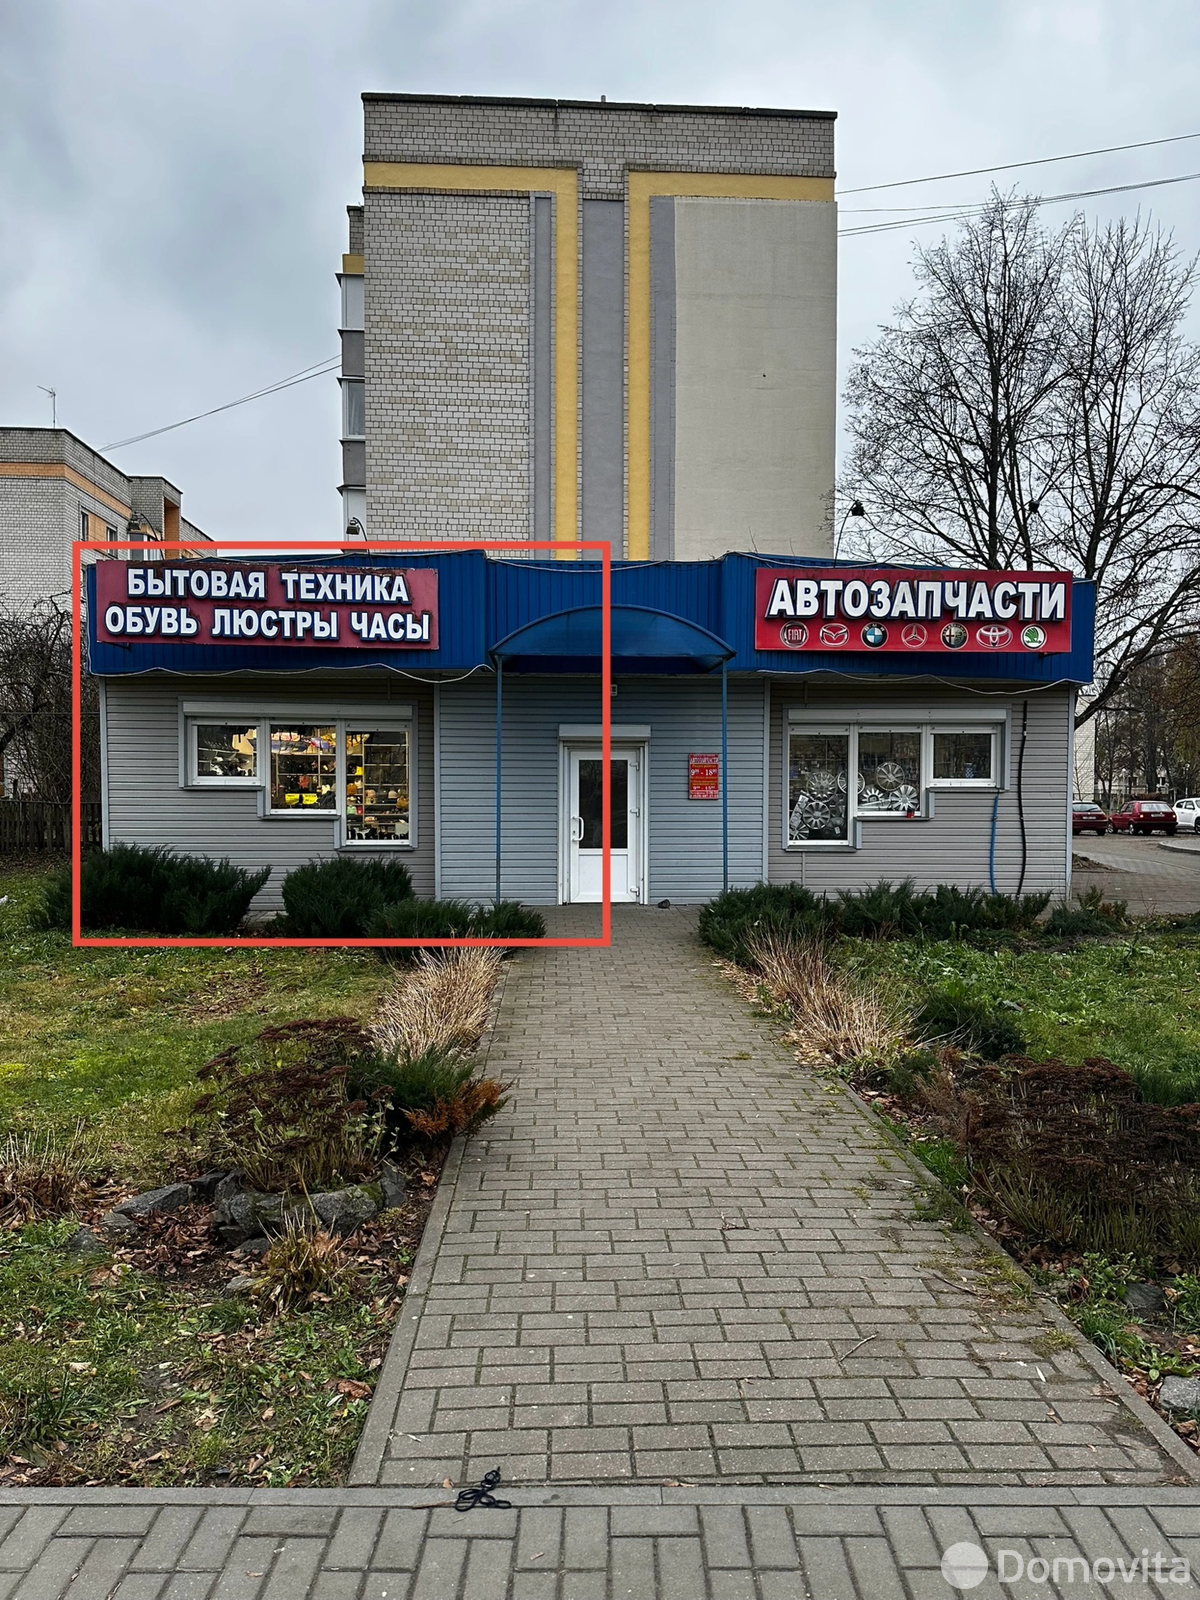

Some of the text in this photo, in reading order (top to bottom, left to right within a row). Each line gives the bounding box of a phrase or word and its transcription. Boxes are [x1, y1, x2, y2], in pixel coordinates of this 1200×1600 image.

[127, 568, 410, 602] БЫТОВАЯ ТЕХНИКА
[767, 579, 1066, 620] АВТОЗАПЧАСТИ
[104, 606, 430, 641] ОБУВЬ ЛЮСТРЫ ЧАСЫ
[787, 628, 803, 641] FIAT
